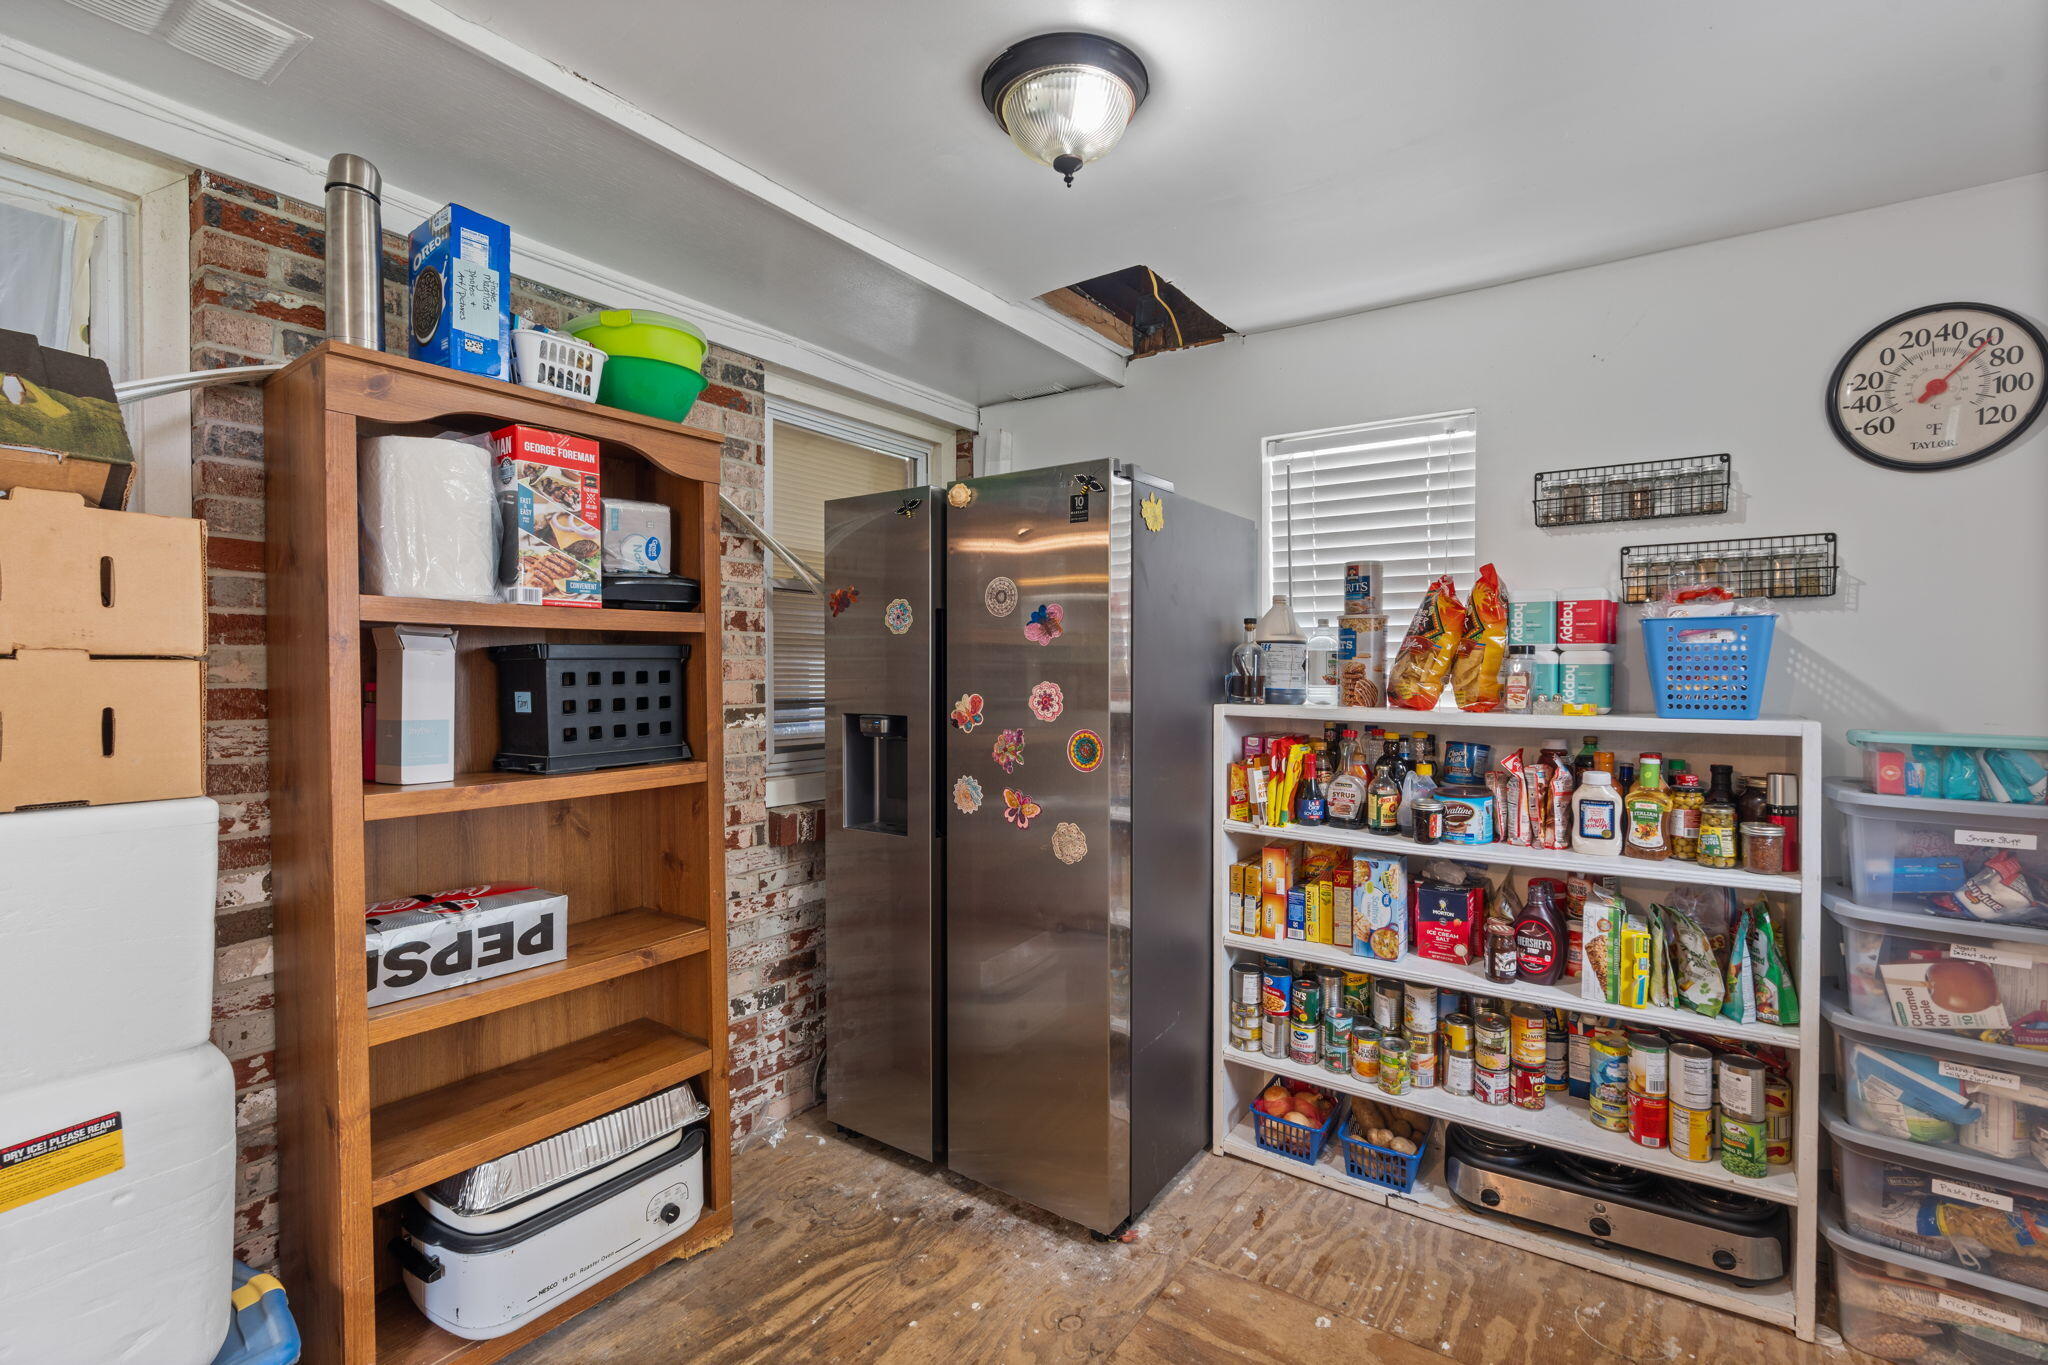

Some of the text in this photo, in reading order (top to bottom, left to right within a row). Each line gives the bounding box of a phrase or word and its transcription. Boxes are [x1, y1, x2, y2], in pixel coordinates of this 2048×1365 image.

[413, 236, 441, 271] OREO
[464, 269, 477, 296] Photos
[1898, 328, 1931, 350] 20
[1934, 321, 1969, 341] 40
[1968, 326, 2004, 349] 60
[1880, 347, 1895, 366] 0
[1989, 345, 2024, 367] 80
[1846, 371, 1884, 392] -20
[1993, 372, 2034, 394] 100
[1842, 394, 1882, 414] -40
[1975, 404, 2017, 426] 120
[1854, 416, 1895, 436] -60
[1926, 422, 1943, 436] °F
[524, 441, 595, 464] GEORGE FOREMAN
[1910, 439, 1956, 450] TAYLOR
[1074, 496, 1084, 507] 10
[651, 539, 659, 558] Great
[569, 581, 597, 591] CONVENIENT
[1511, 603, 1528, 643] happy
[1560, 602, 1577, 642] happy
[1562, 665, 1579, 704] happy
[1332, 791, 1356, 799] SYRUP
[1966, 879, 2002, 912] ampfire
[1432, 909, 1455, 917] MORTON
[1437, 931, 1459, 939] CREAM
[1517, 935, 1552, 951] HERSHEY'S
[366, 912, 554, 993] PEPSI
[1902, 987, 1923, 1027] Caramel
[1924, 999, 1936, 1027] Apple
[1939, 1013, 1952, 1027] Kit
[1962, 1015, 1973, 1025] 10
[3, 1118, 116, 1163] DRY ICE! PLEASE READ!
[538, 1281, 558, 1296] NESCO
[580, 1260, 600, 1273] Roaster
[601, 1251, 615, 1262] Oven
